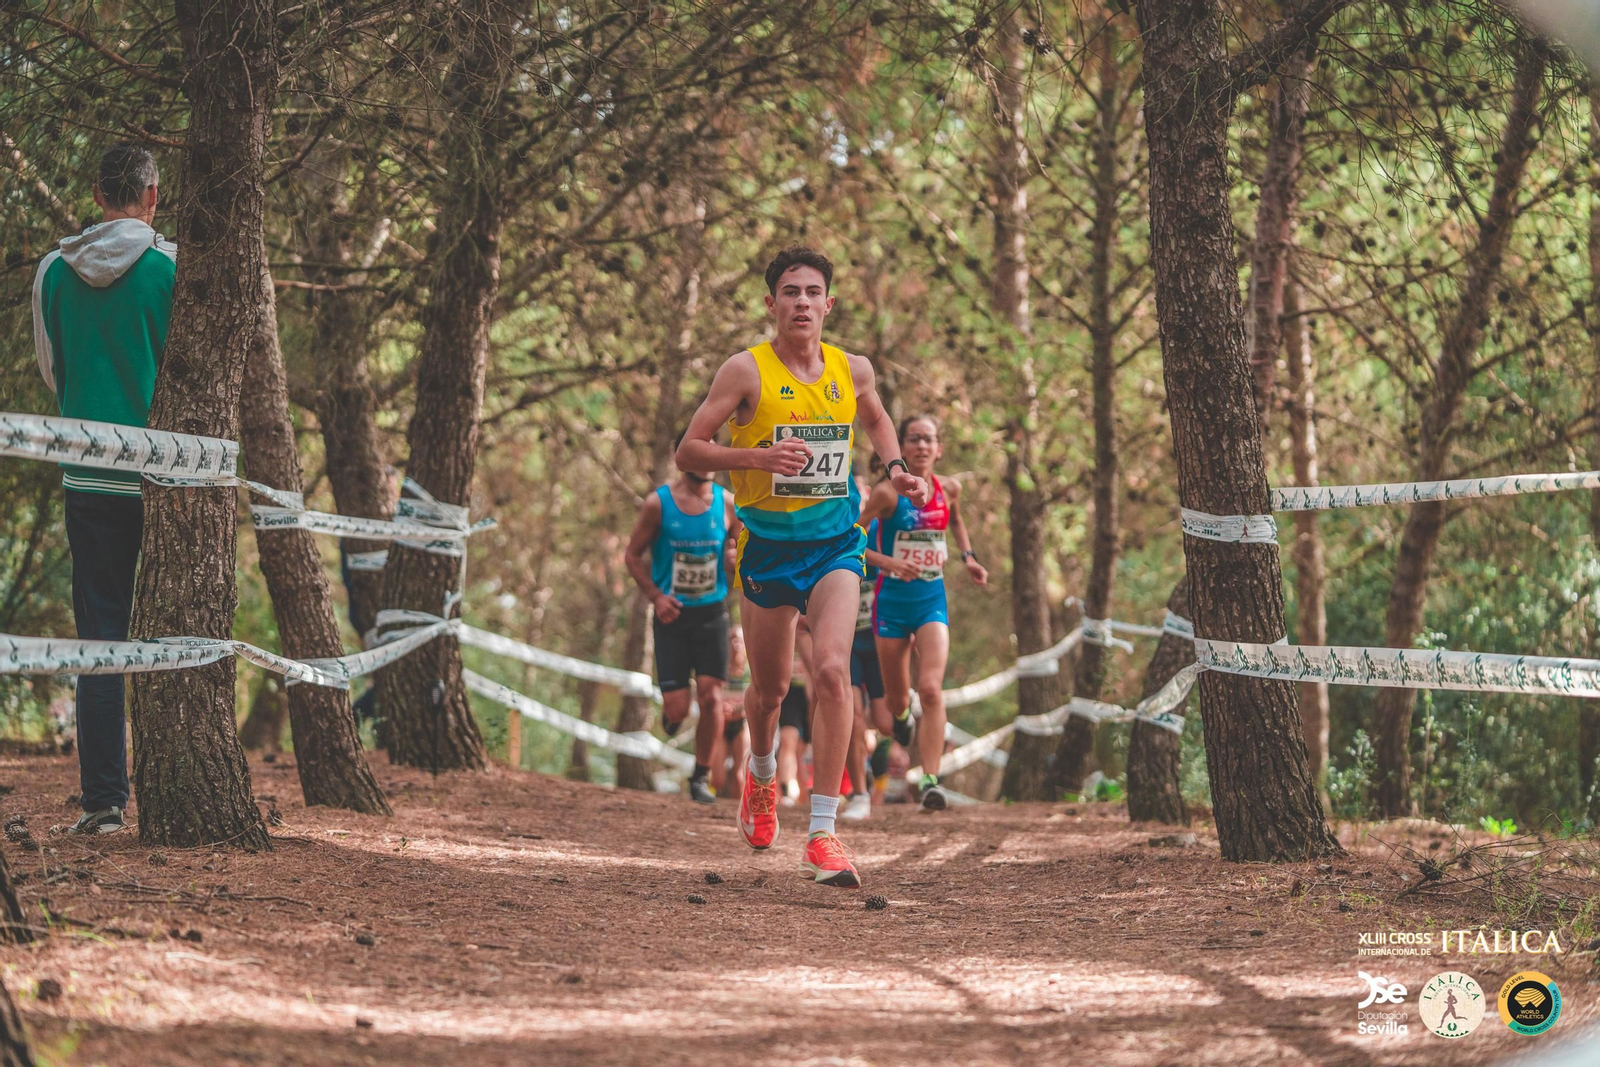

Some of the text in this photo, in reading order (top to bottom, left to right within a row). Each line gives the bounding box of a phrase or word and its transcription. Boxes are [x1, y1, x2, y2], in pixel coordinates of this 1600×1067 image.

[797, 427, 834, 437] ITÁLICA
[783, 452, 844, 478] 247
[264, 516, 298, 526] Sevilla
